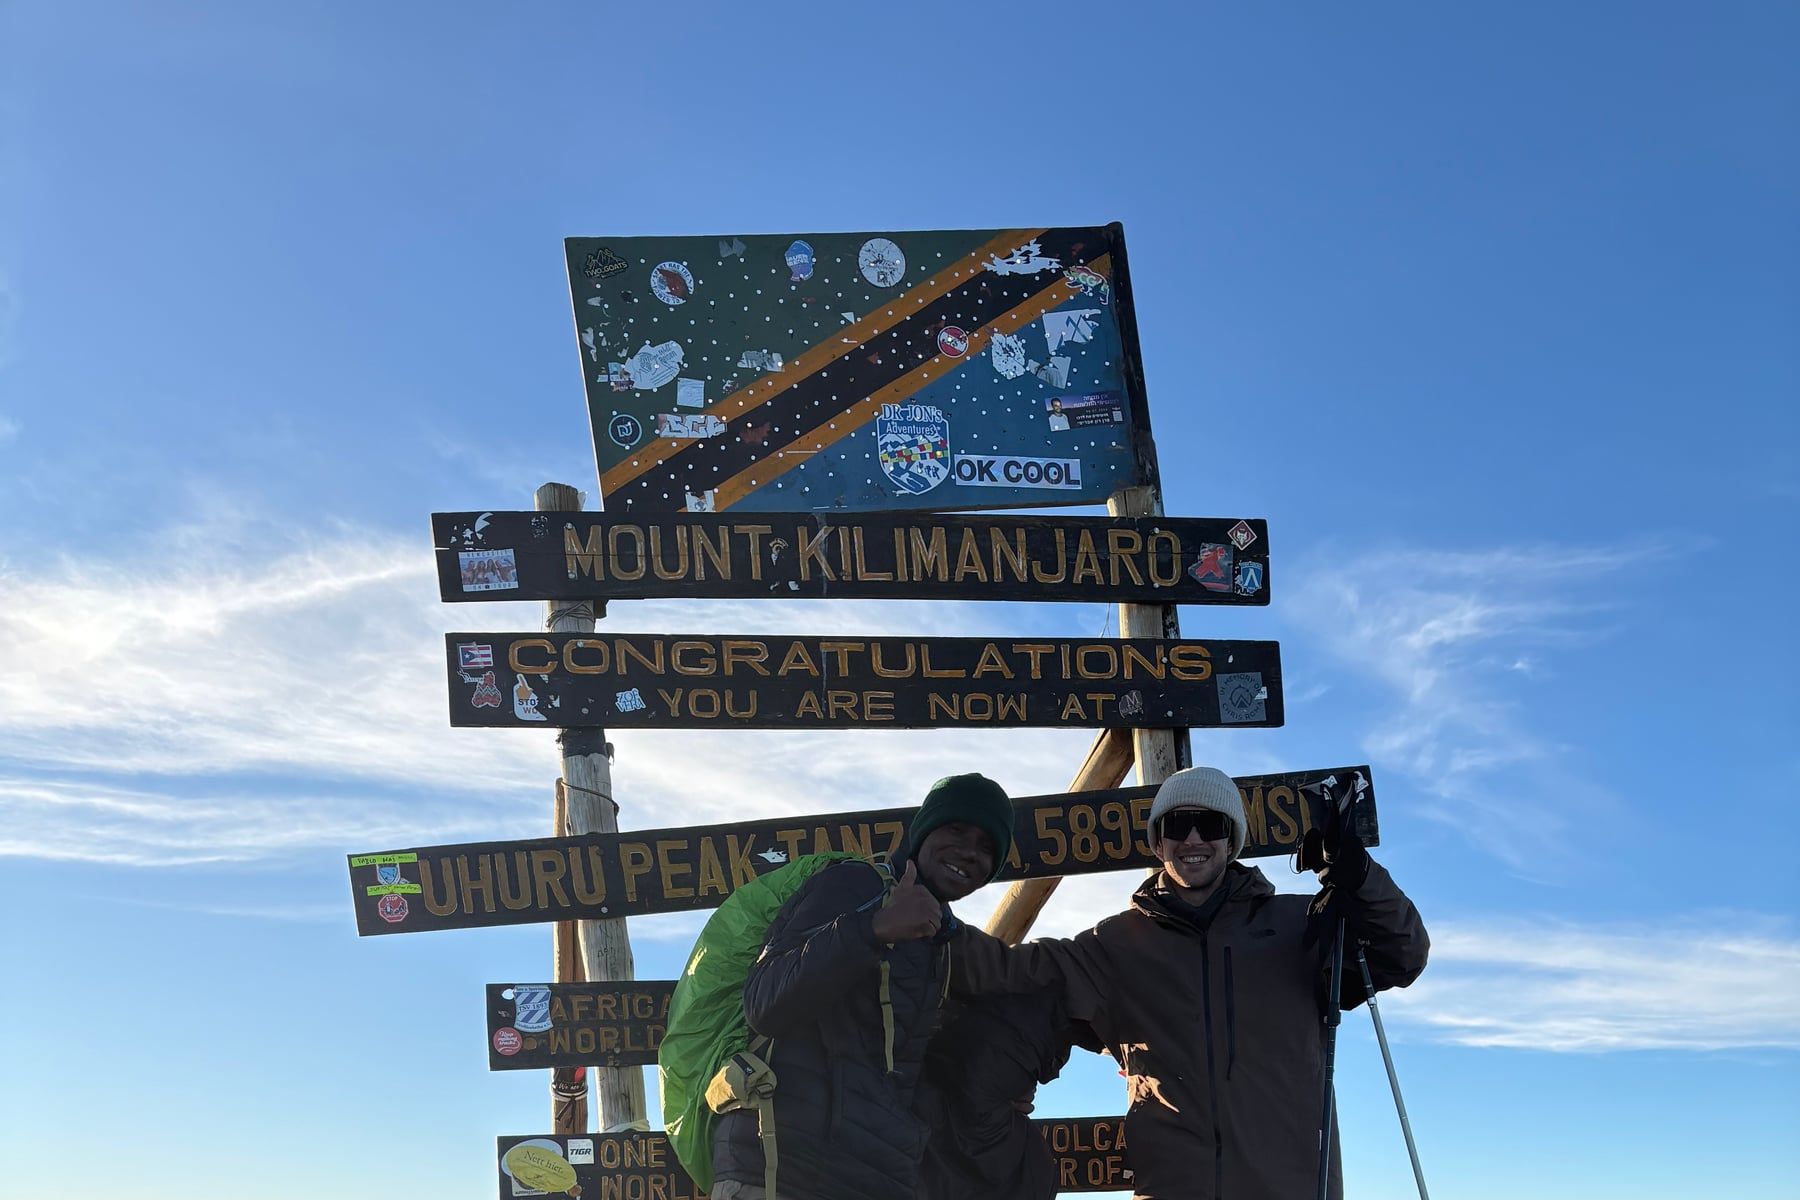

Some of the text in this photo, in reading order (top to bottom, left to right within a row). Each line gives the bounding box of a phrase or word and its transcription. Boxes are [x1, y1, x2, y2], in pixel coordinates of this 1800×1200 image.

[881, 403, 902, 421] DR
[886, 422, 935, 436] Adventures
[955, 459, 1081, 486] OK COOL
[564, 522, 1182, 587] MOUNT KILIMANJARO
[508, 638, 1212, 682] CONGRATULATIONS
[657, 688, 1116, 721] YOU ARE NOW AT
[418, 843, 608, 917] UHURU
[620, 834, 758, 903] PEAK
[1034, 797, 1154, 865] 5895
[549, 1023, 667, 1055] WORLD
[569, 1148, 592, 1156] TIGR
[600, 1137, 667, 1169] ONE
[1087, 1155, 1122, 1186] OF
